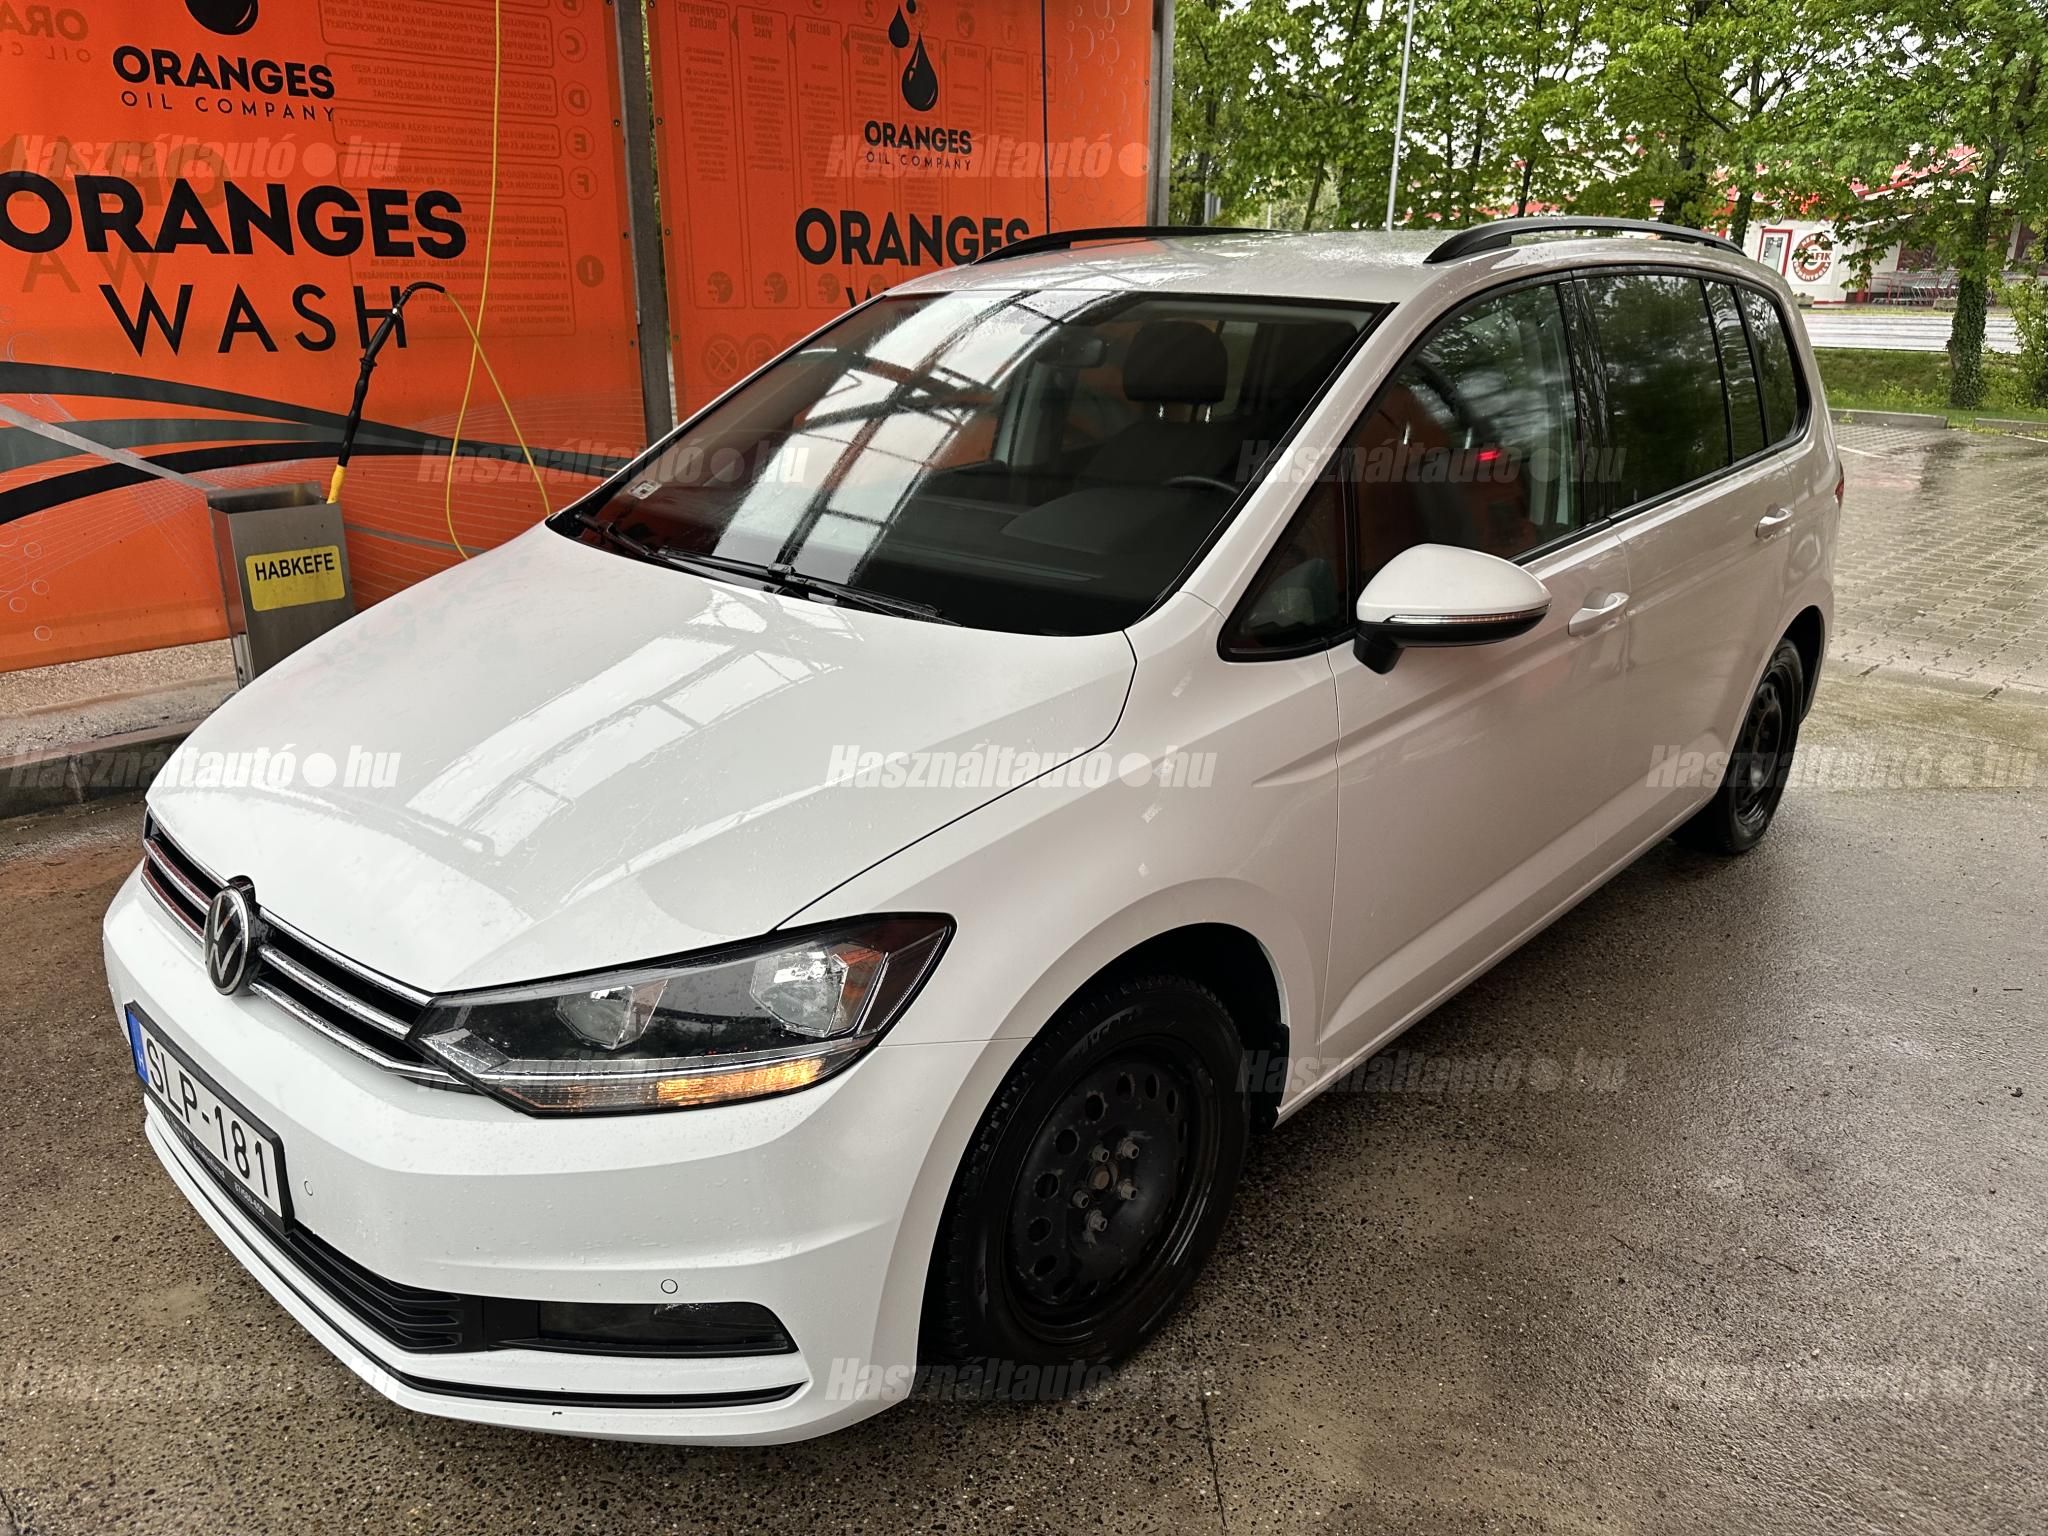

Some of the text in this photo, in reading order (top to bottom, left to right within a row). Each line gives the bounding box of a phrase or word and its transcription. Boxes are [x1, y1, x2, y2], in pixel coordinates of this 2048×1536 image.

[112, 45, 335, 100] ORANGES
[121, 90, 335, 122] OIL COMPANY
[864, 120, 972, 155] ORANGES
[866, 151, 972, 172] OIL COMPANY
[0, 170, 467, 257] ORANGES
[99, 284, 408, 356] WASH
[255, 551, 335, 583] HABKEFE
[146, 1037, 268, 1199] SLP-181
